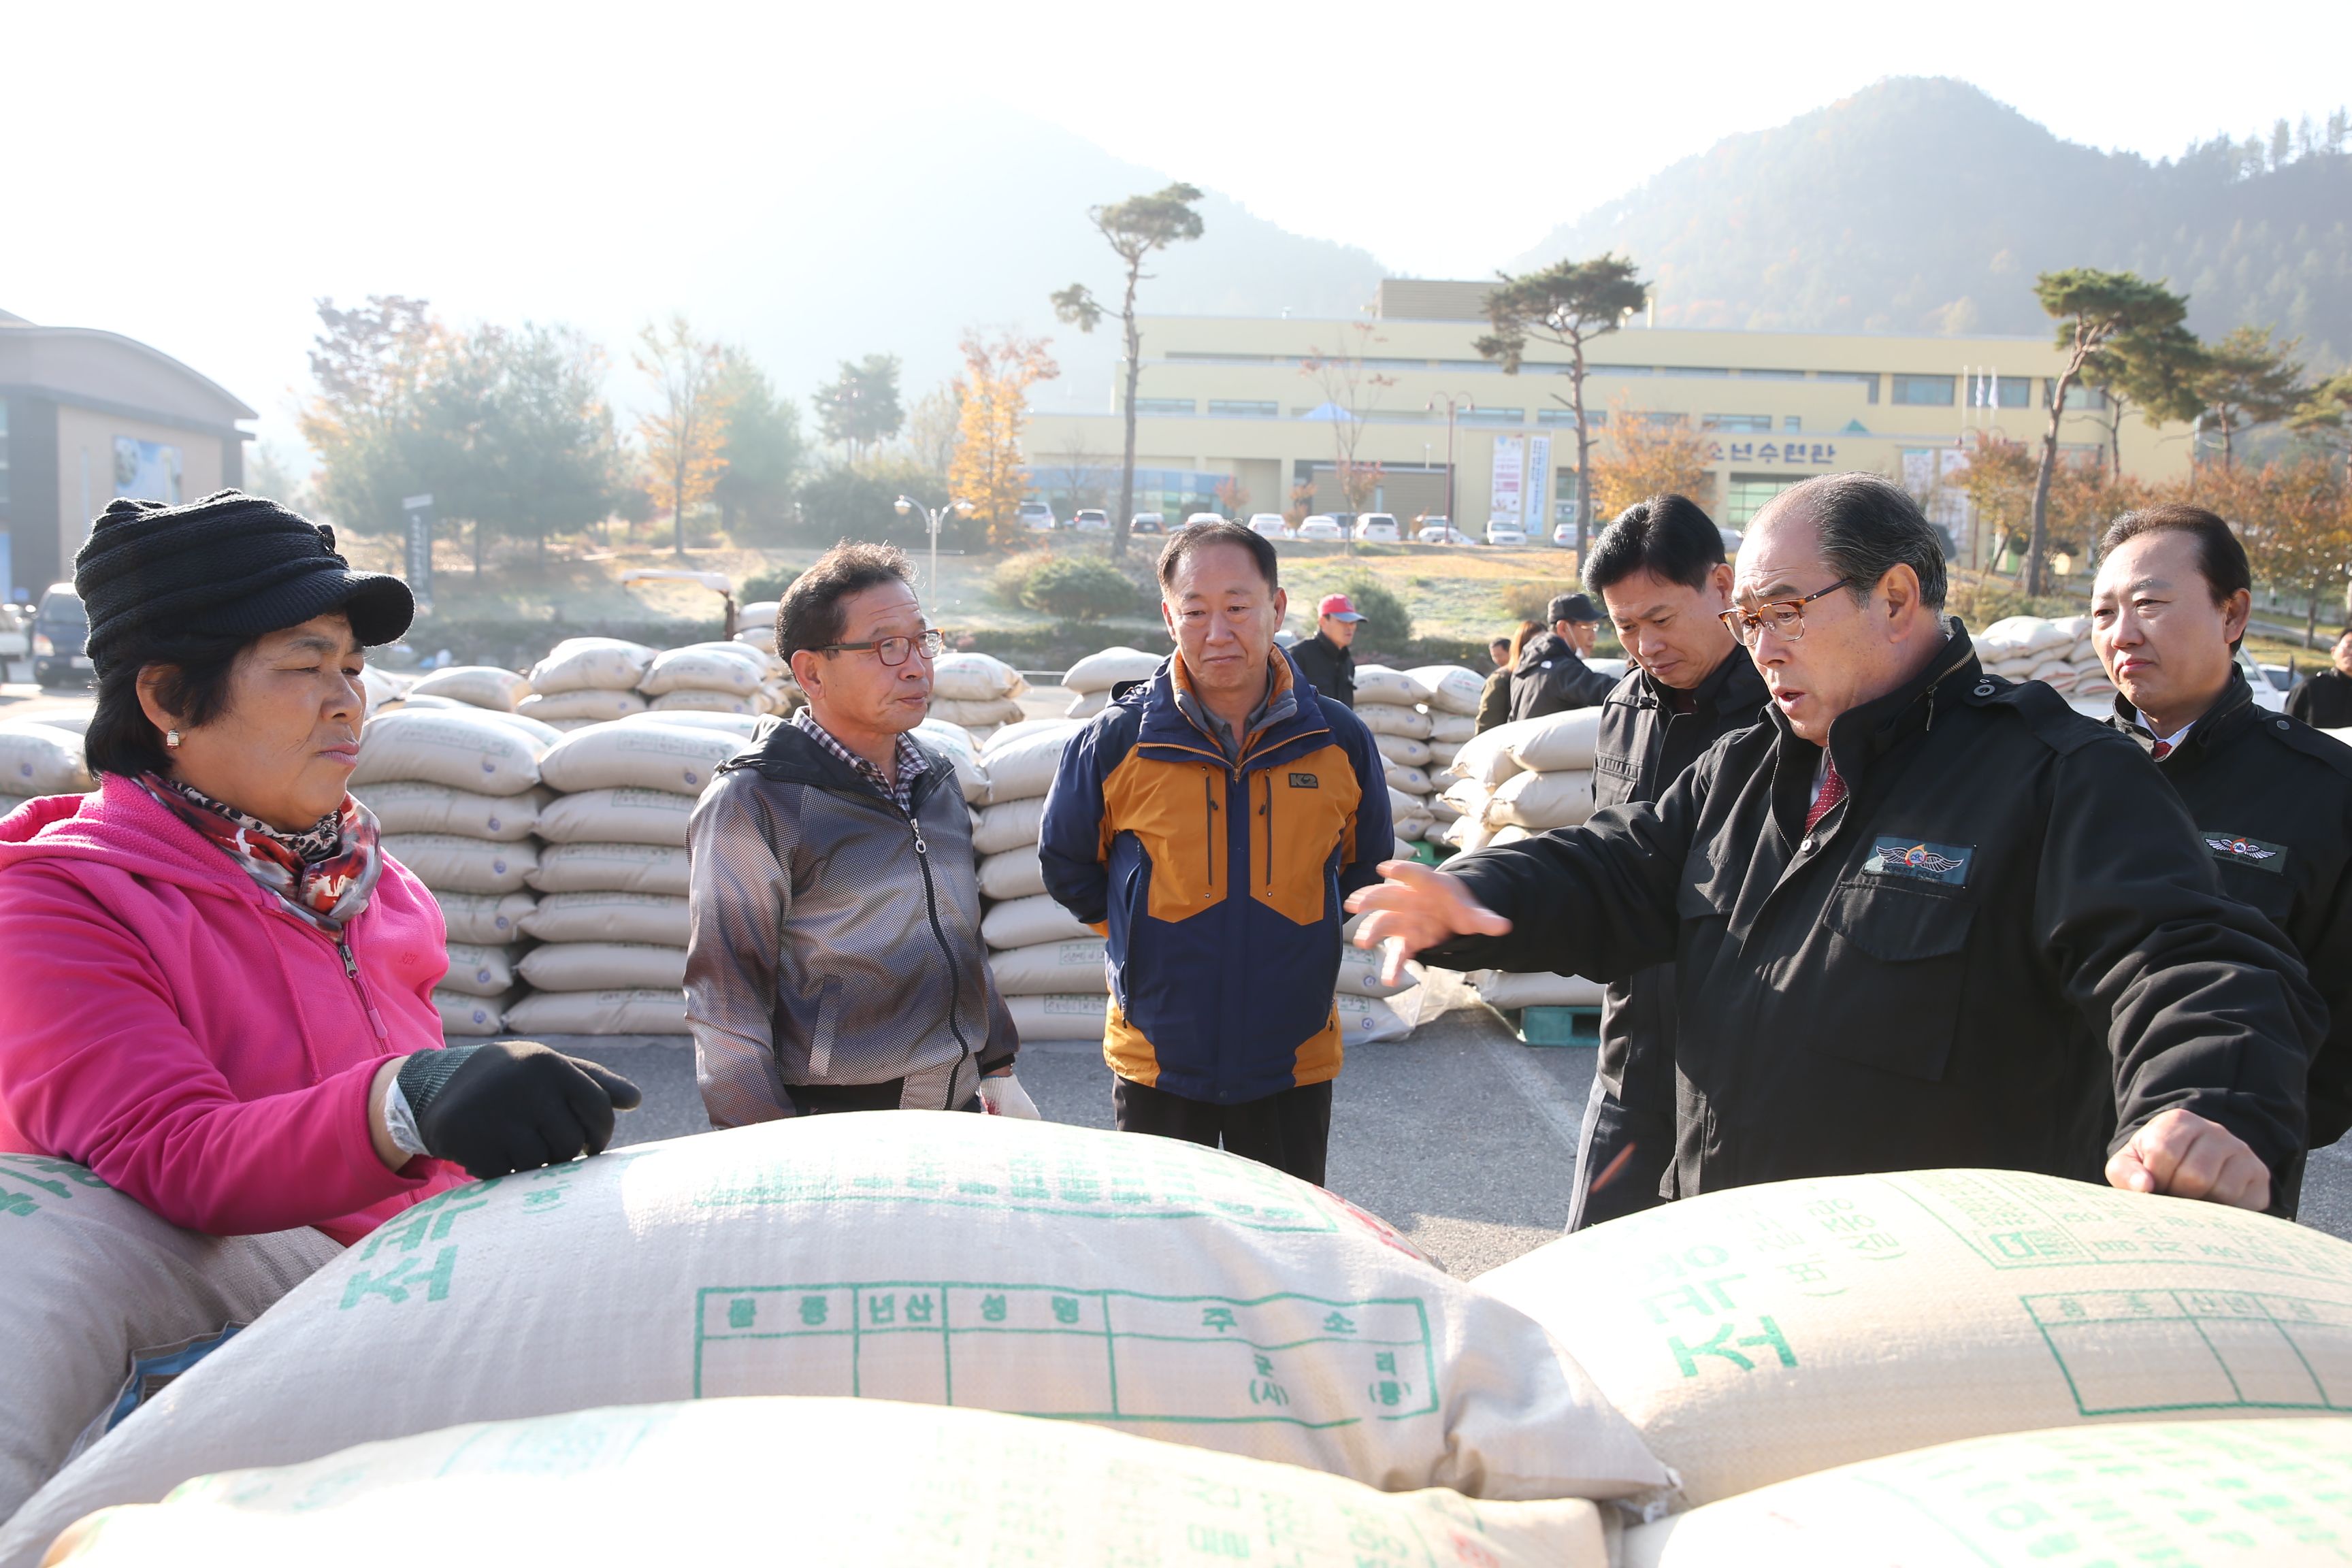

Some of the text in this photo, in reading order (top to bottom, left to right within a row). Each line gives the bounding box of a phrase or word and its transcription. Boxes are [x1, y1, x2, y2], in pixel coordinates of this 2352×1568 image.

[1698, 441, 1836, 464] 소년수련관
[1290, 774, 1318, 787] K2
[1882, 864, 1944, 880] FOREST POLICE
